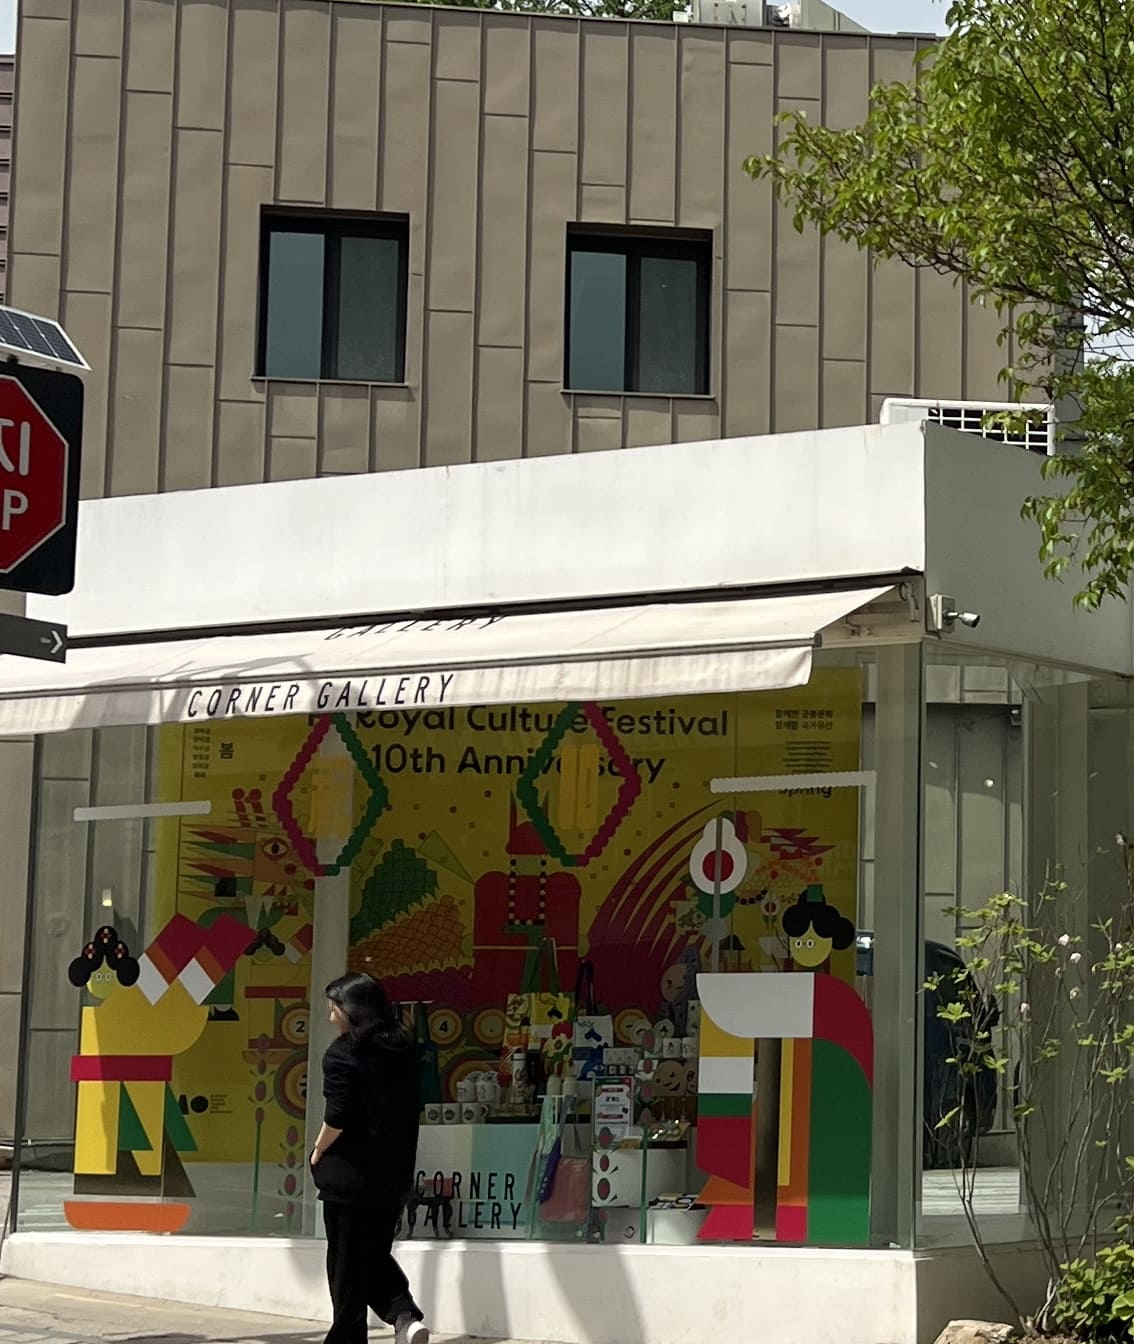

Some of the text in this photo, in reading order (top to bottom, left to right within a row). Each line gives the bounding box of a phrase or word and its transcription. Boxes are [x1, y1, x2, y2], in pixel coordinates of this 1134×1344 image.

[187, 674, 454, 718] CORNER GALLERY
[467, 703, 589, 734] Cultue
[602, 705, 728, 737] Festival
[219, 742, 235, 760] 봄
[371, 744, 446, 775] 10th
[415, 1169, 515, 1200] CORNER
